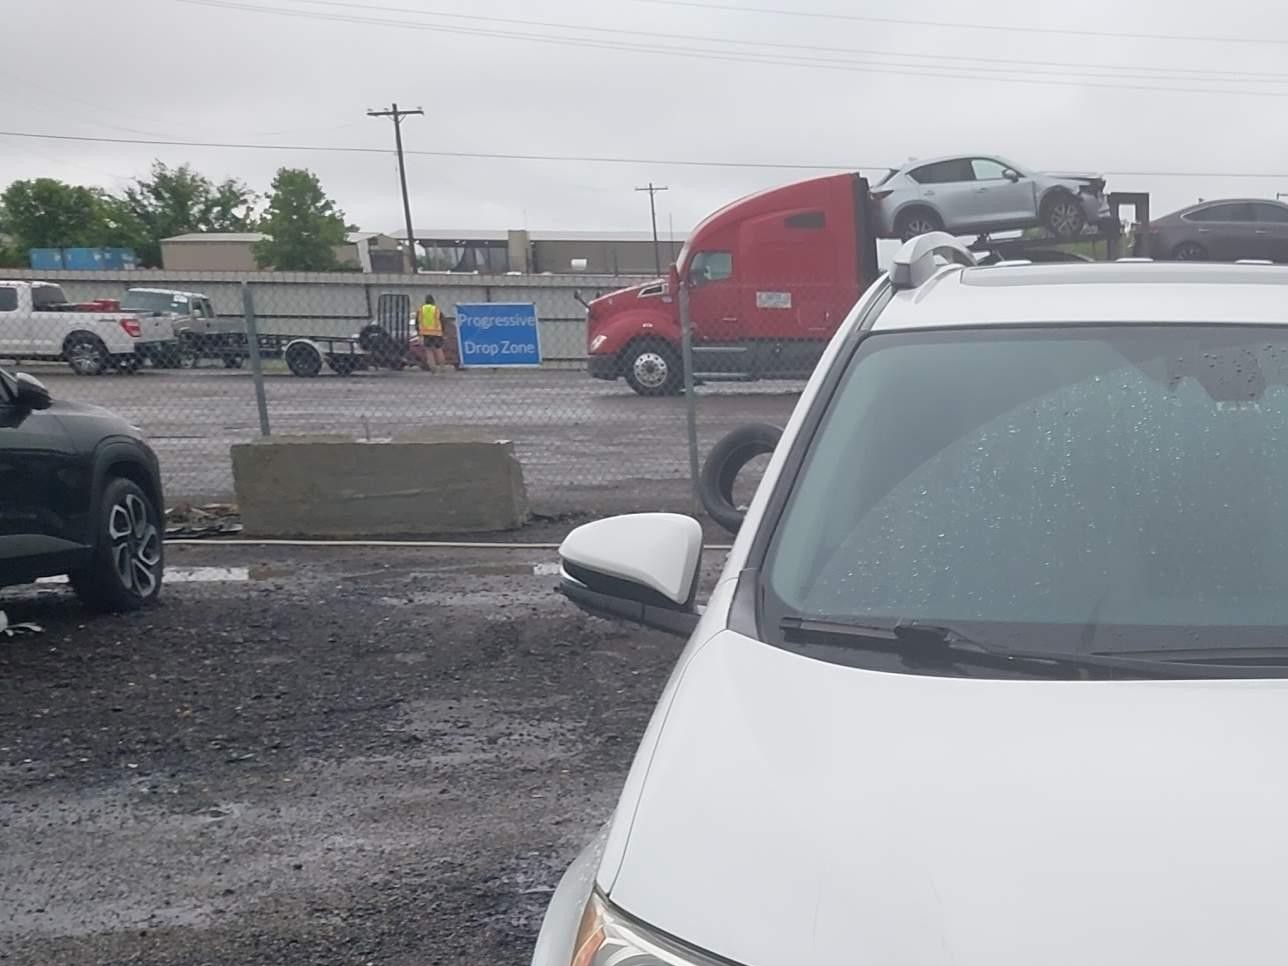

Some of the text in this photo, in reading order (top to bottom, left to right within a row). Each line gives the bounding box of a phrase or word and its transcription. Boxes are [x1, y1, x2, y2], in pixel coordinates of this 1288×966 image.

[458, 313, 536, 329] Progressive
[464, 341, 535, 356] Drop Zone
